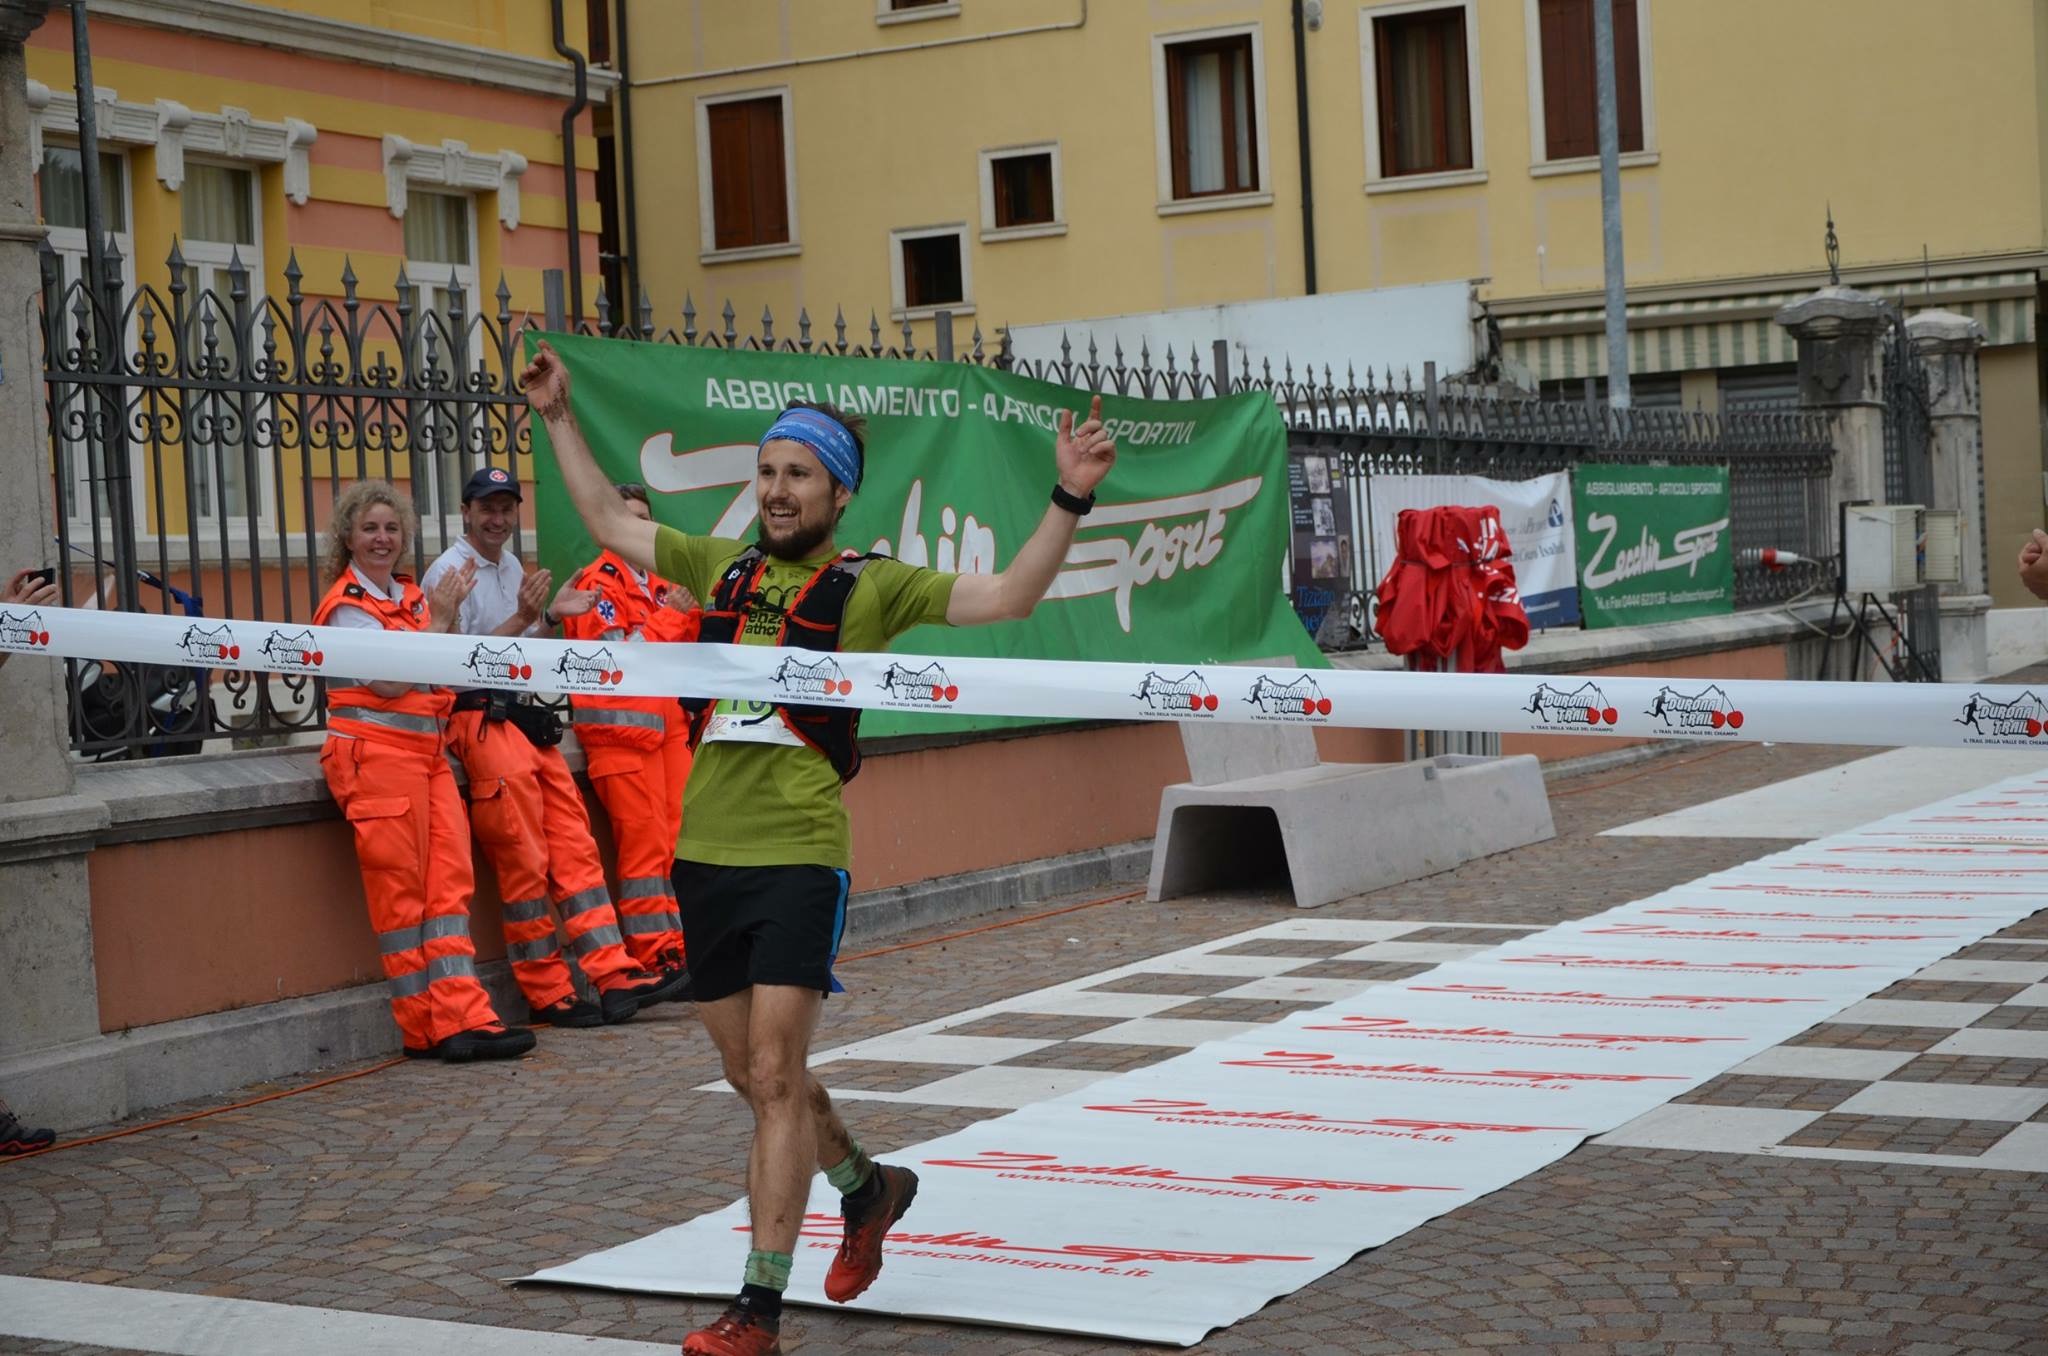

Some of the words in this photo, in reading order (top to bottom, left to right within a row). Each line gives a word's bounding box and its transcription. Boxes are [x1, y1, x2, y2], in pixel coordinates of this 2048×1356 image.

[983, 393, 1080, 437] ARTICOL
[1586, 482, 1654, 496] ABBIGLIAMENTO
[1659, 482, 1690, 496] ARTICOLI
[1583, 512, 1661, 590] Zecchin
[1673, 518, 1730, 578] Sport
[796, 679, 826, 692] TRAIL
[896, 673, 938, 686] DURONA
[905, 686, 933, 700] TRAIL
[1151, 682, 1196, 696] DURONA
[1263, 686, 1309, 700] DURONA
[1162, 696, 1192, 710] TRAIL
[1274, 699, 1304, 714] TRAIL
[1544, 694, 1593, 708] DURONA
[1666, 698, 1719, 713] DURONA
[1557, 708, 1588, 723] TRAIL
[1680, 712, 1713, 727] TRAIL
[1978, 705, 2033, 720] DURONA
[1993, 720, 2029, 736] TRAIL
[1154, 1116, 1457, 1143] www.zecchinsport.it
[996, 1172, 1320, 1203] www.zecchinsport.it
[1062, 1244, 1315, 1264] Sport
